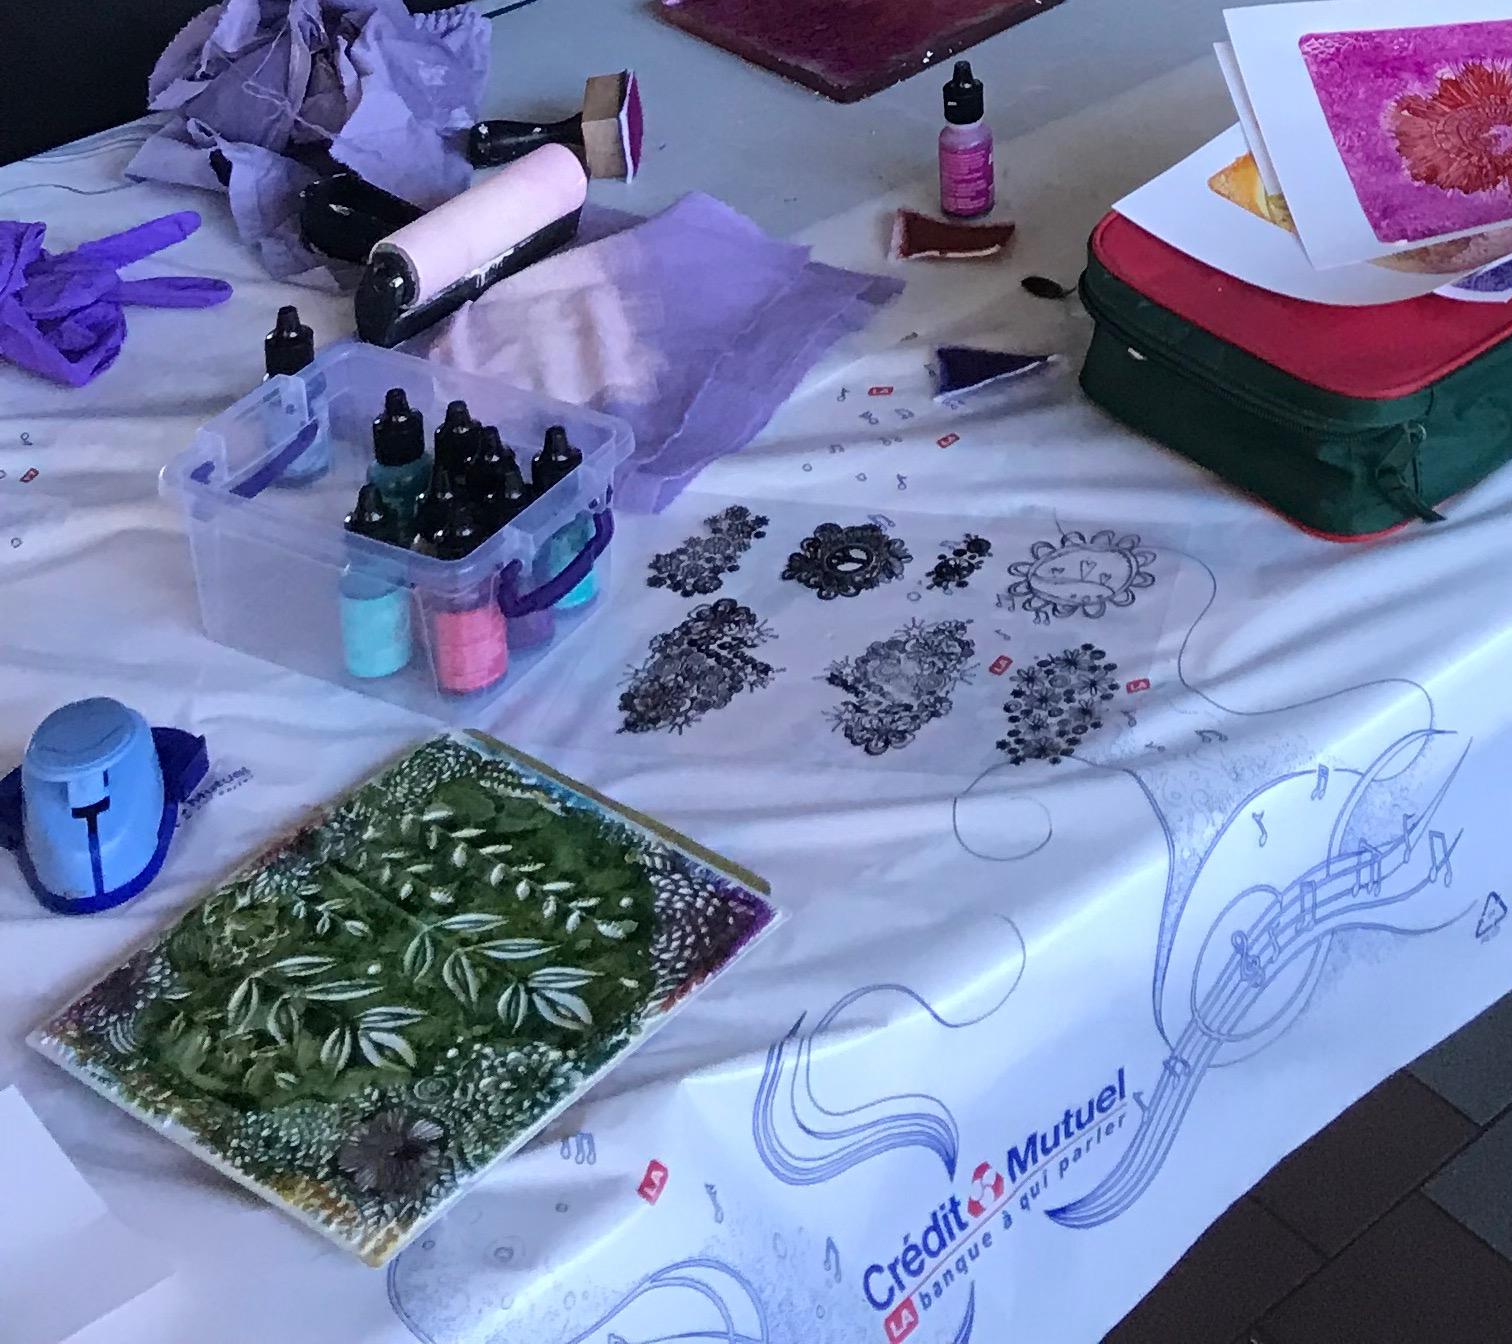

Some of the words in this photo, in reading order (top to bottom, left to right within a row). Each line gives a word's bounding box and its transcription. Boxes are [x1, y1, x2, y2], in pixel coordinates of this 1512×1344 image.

[862, 1194, 969, 1311] Crédit
[1006, 1067, 1127, 1184] Mutuel
[887, 1303, 917, 1340] LA
[919, 1230, 993, 1311] banque
[1002, 1209, 1014, 1230] à
[1018, 1168, 1050, 1213] qui
[1058, 1111, 1127, 1180] parler
